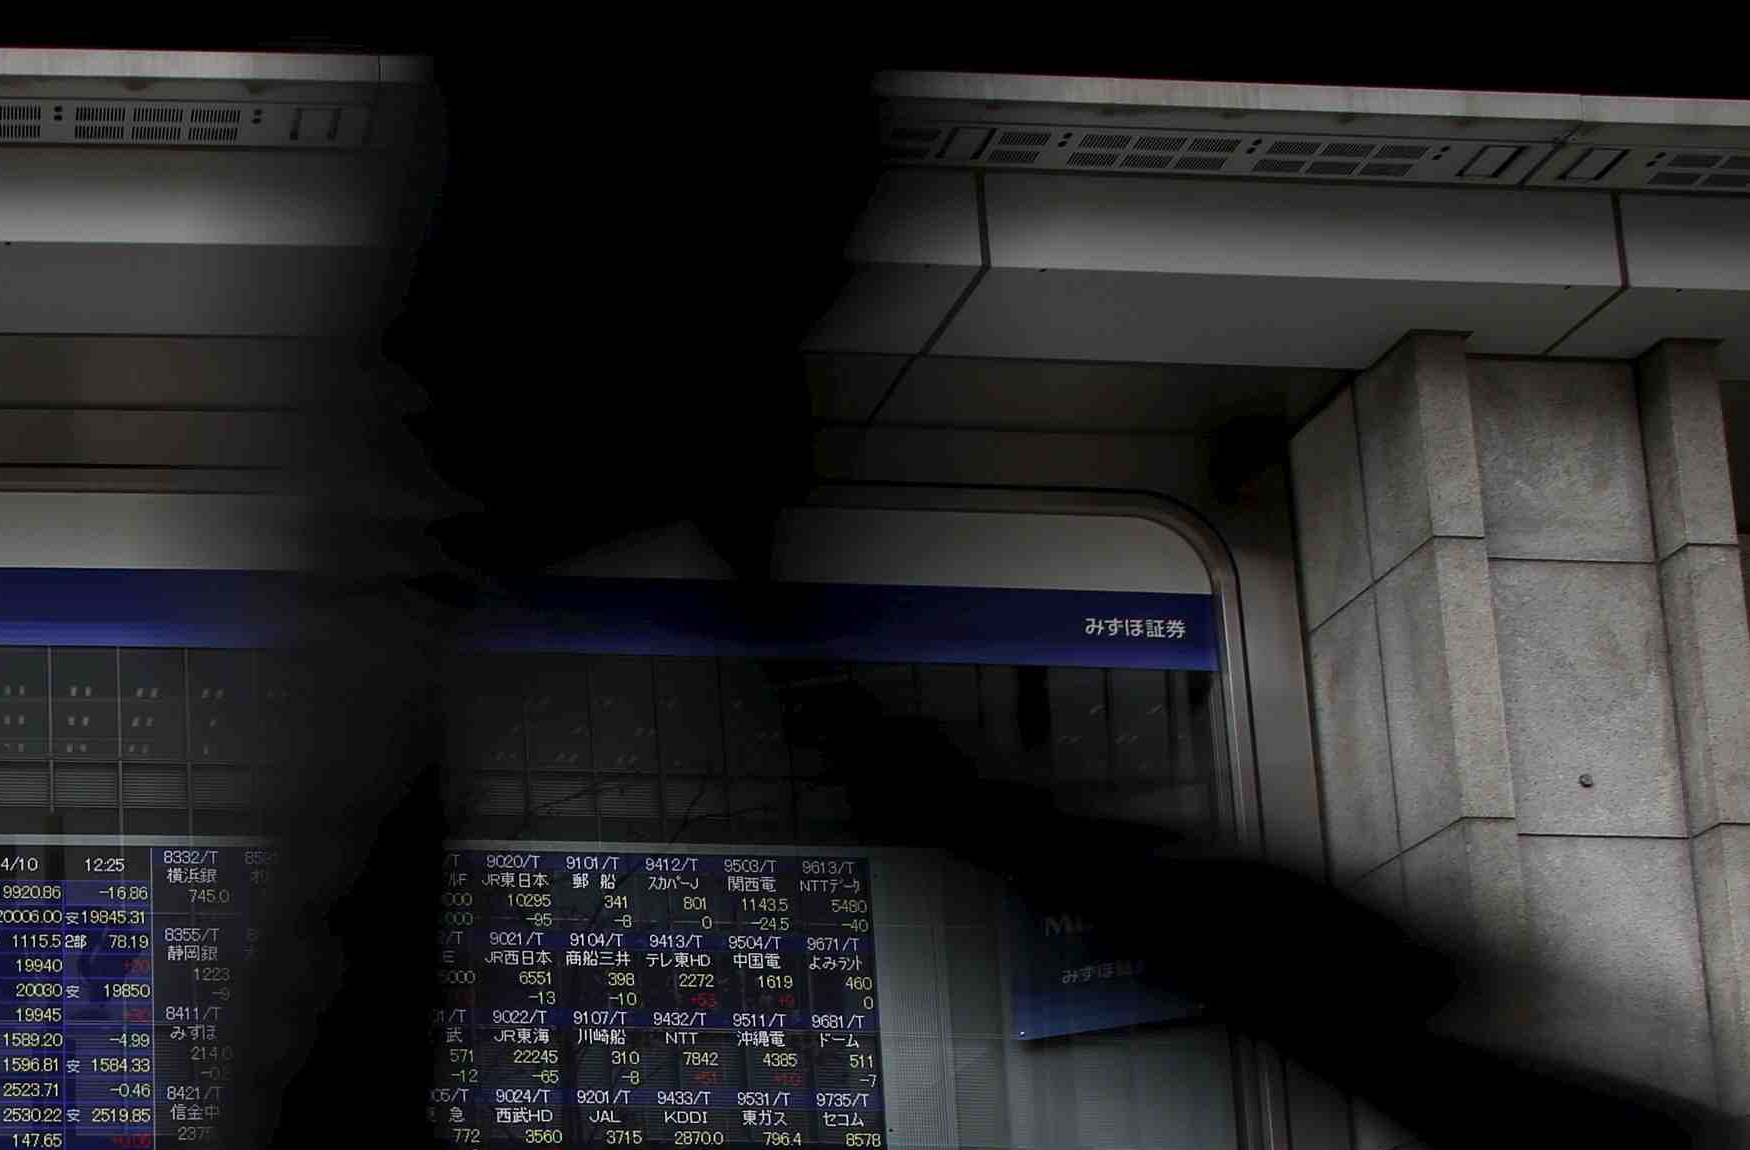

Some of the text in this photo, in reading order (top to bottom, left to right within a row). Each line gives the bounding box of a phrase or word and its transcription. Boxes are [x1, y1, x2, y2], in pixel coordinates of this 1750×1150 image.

[1084, 617, 1186, 642] みずほ証券
[163, 850, 218, 864] 8332/T
[485, 855, 540, 869] 9020/T
[0, 858, 38, 871] 4/10
[645, 859, 698, 872] 9412/T
[802, 860, 855, 874] 9613/T
[167, 867, 218, 884] 横浜銀
[482, 872, 550, 888] JR東日本
[728, 877, 776, 892] 関西電
[800, 880, 860, 893] NTTデータ
[188, 888, 230, 903] 745.0
[508, 893, 551, 906] 10295
[604, 895, 628, 909] 341
[683, 897, 706, 910] 801
[742, 898, 788, 911] 1143.5
[65, 913, 79, 926] 安
[82, 910, 145, 924] 19845.31
[12, 935, 61, 948] 1115.5
[65, 934, 87, 949] 2部
[110, 935, 148, 949] 78.19
[164, 928, 220, 942] 8355/T
[489, 932, 544, 945] 9021/T
[570, 934, 623, 947] 9104/T
[649, 935, 703, 948] 9413/T
[728, 936, 782, 950] 9504/T
[807, 938, 859, 951] 9671/T
[167, 946, 218, 962] 静岡銀
[484, 951, 552, 966] JR西日本
[565, 951, 631, 967] 商船三井
[645, 953, 711, 968] テレ東HD
[16, 959, 62, 972] 19940
[733, 954, 780, 969] 中国電
[519, 972, 552, 985] 6551
[607, 973, 635, 986] 398
[679, 974, 714, 988] 2272
[758, 976, 793, 989] 1619
[845, 977, 873, 990] 460
[66, 985, 80, 998] 安
[104, 984, 150, 998] 19850
[15, 1008, 61, 1022] 19945
[166, 1006, 220, 1021] 8411/T
[492, 1010, 547, 1024] 9022/T
[573, 1011, 627, 1024] 9107/T
[653, 1012, 707, 1026] 9432/T
[733, 1013, 787, 1027] 9511/T
[811, 1015, 865, 1029] 9681/T
[3, 1033, 63, 1047] 1589.20
[110, 1034, 149, 1047] -4.99
[171, 1025, 217, 1041] みずほ
[494, 1028, 550, 1043] JR東海
[577, 1029, 626, 1045] 川崎船
[666, 1032, 698, 1044] NTT
[737, 1031, 785, 1047] 沖縄電
[819, 1033, 859, 1048] ドーム
[514, 1049, 558, 1064] 22245
[612, 1051, 640, 1064] 310
[683, 1052, 718, 1066] 7842
[763, 1053, 797, 1067] 4385
[849, 1054, 873, 1068] 511
[3, 1058, 150, 1073] 1596.81 安 1584.33
[3, 1084, 59, 1097] 2523.71
[110, 1084, 150, 1097] -0.46
[167, 1086, 223, 1100] 8421/T
[496, 1089, 551, 1103] 9024/T
[577, 1090, 631, 1104] 9201/T
[658, 1091, 711, 1105] 9433/T
[737, 1092, 791, 1106] 9531/T
[816, 1093, 869, 1107] 9735/T
[3, 1108, 151, 1123] 2530.22 安 2519.85
[171, 1103, 220, 1121] 信金中
[496, 1107, 553, 1124] 西武HD
[589, 1110, 620, 1123] JAL
[664, 1111, 707, 1124] KDDI
[742, 1110, 788, 1126] 東ガス
[823, 1112, 864, 1127] セコム
[12, 1134, 62, 1148] 147.65
[526, 1129, 562, 1143] 3560
[606, 1130, 642, 1144] 3715
[674, 1132, 723, 1145] 2870.0
[763, 1133, 802, 1146] 796.4
[846, 1134, 881, 1148] 8578
